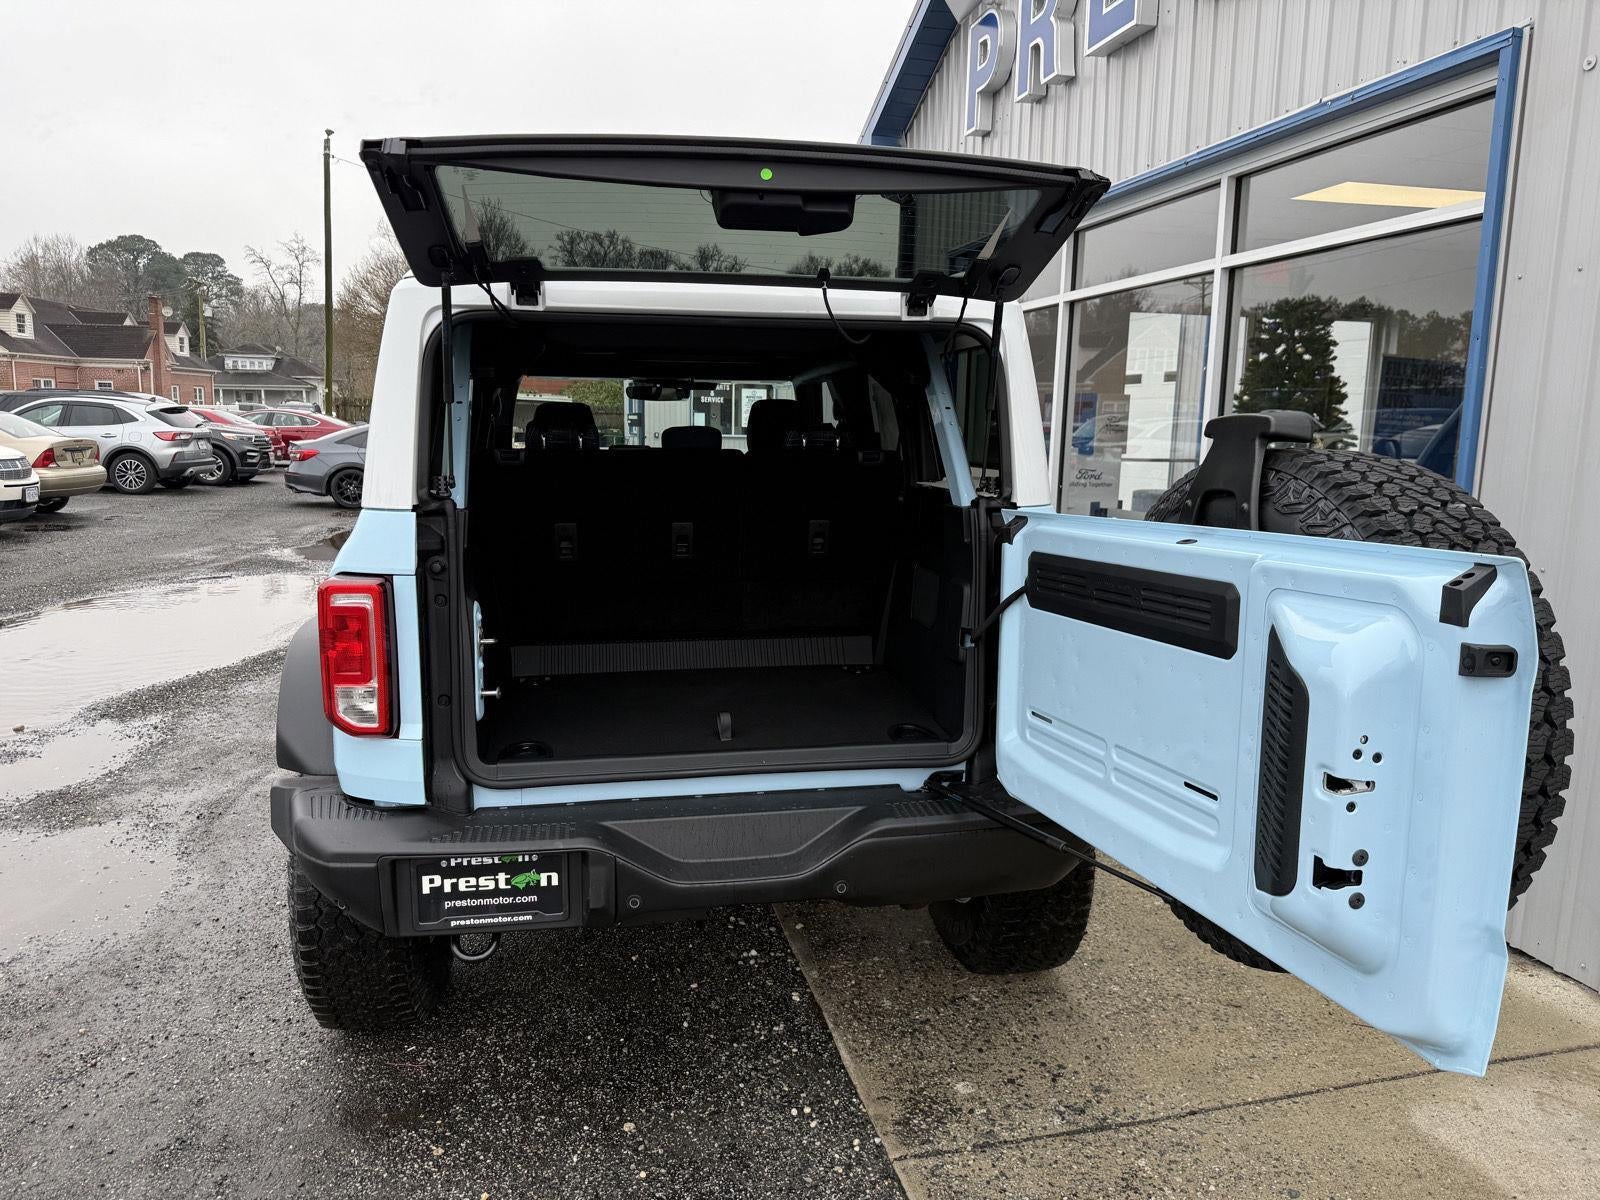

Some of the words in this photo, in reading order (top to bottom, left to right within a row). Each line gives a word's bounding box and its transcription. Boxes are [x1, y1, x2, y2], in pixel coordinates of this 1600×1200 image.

[700, 396, 724, 404] SERVICE
[1075, 468, 1103, 480] Ford
[444, 894, 538, 910] prestonmotor.com
[450, 914, 533, 927] prestonmotor.com
